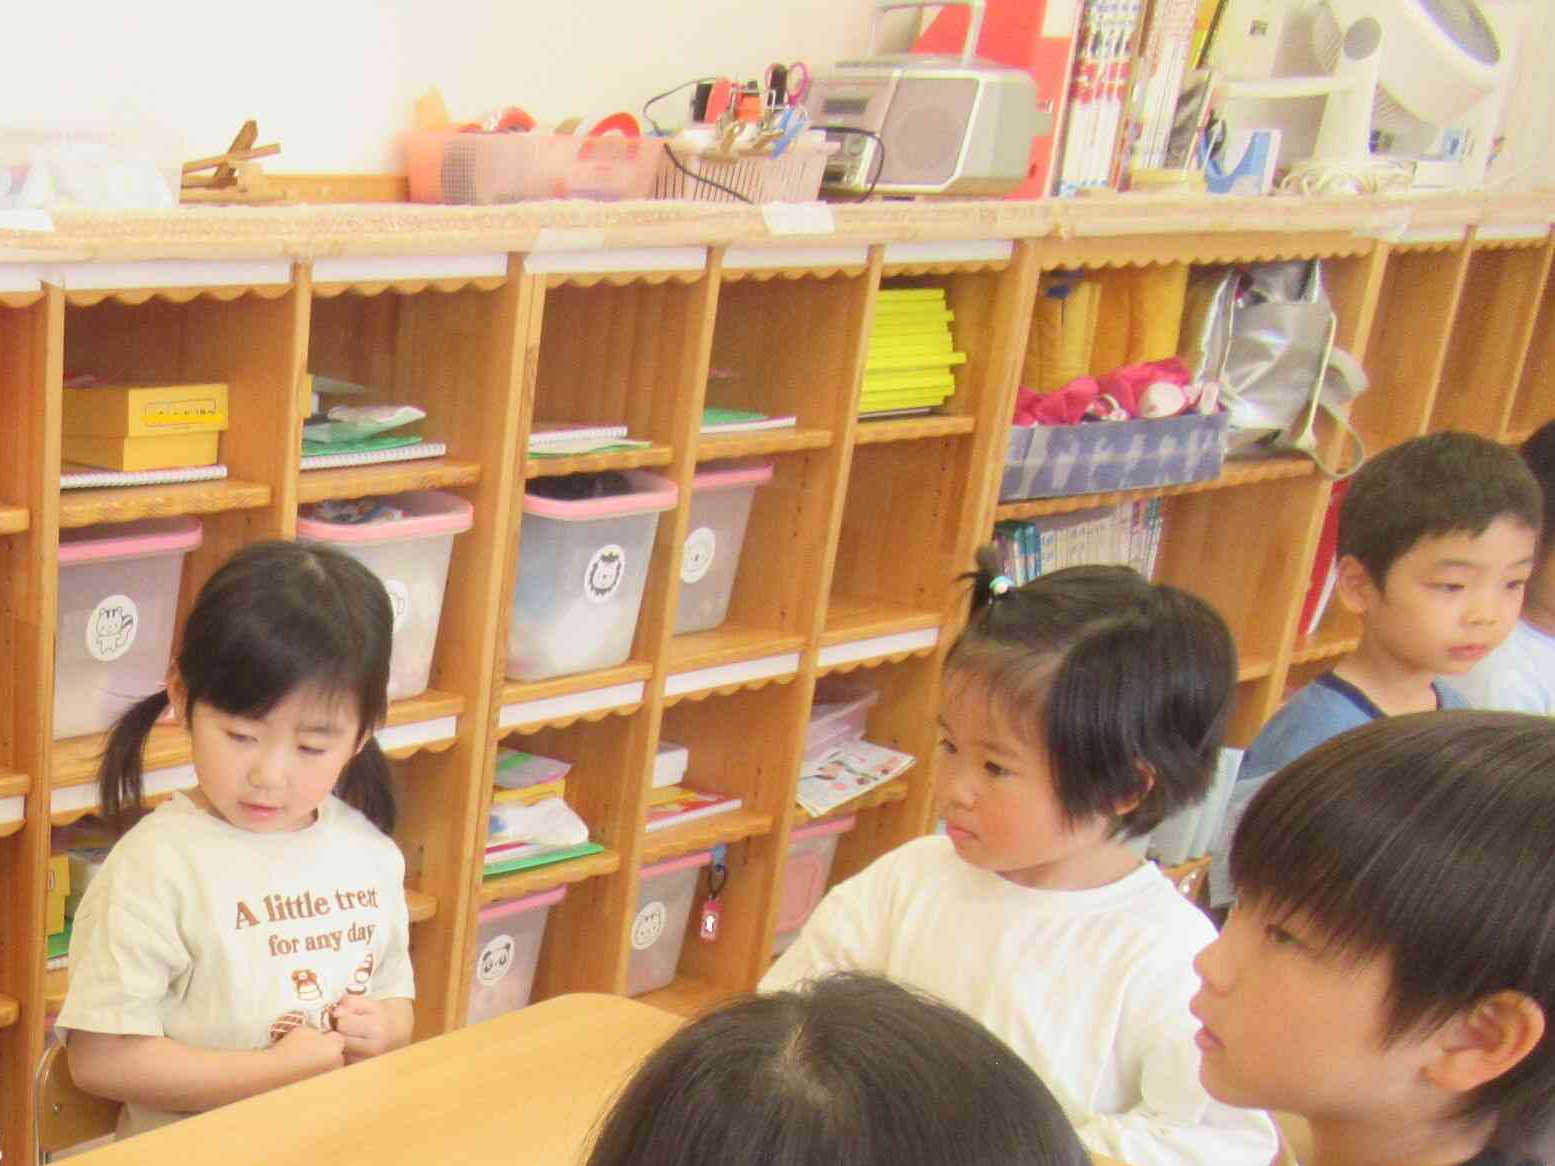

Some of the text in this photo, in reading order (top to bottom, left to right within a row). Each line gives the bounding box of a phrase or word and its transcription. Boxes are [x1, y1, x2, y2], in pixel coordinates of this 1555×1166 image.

[235, 901, 260, 930] A
[263, 890, 331, 922] little
[268, 921, 376, 957] for any day
